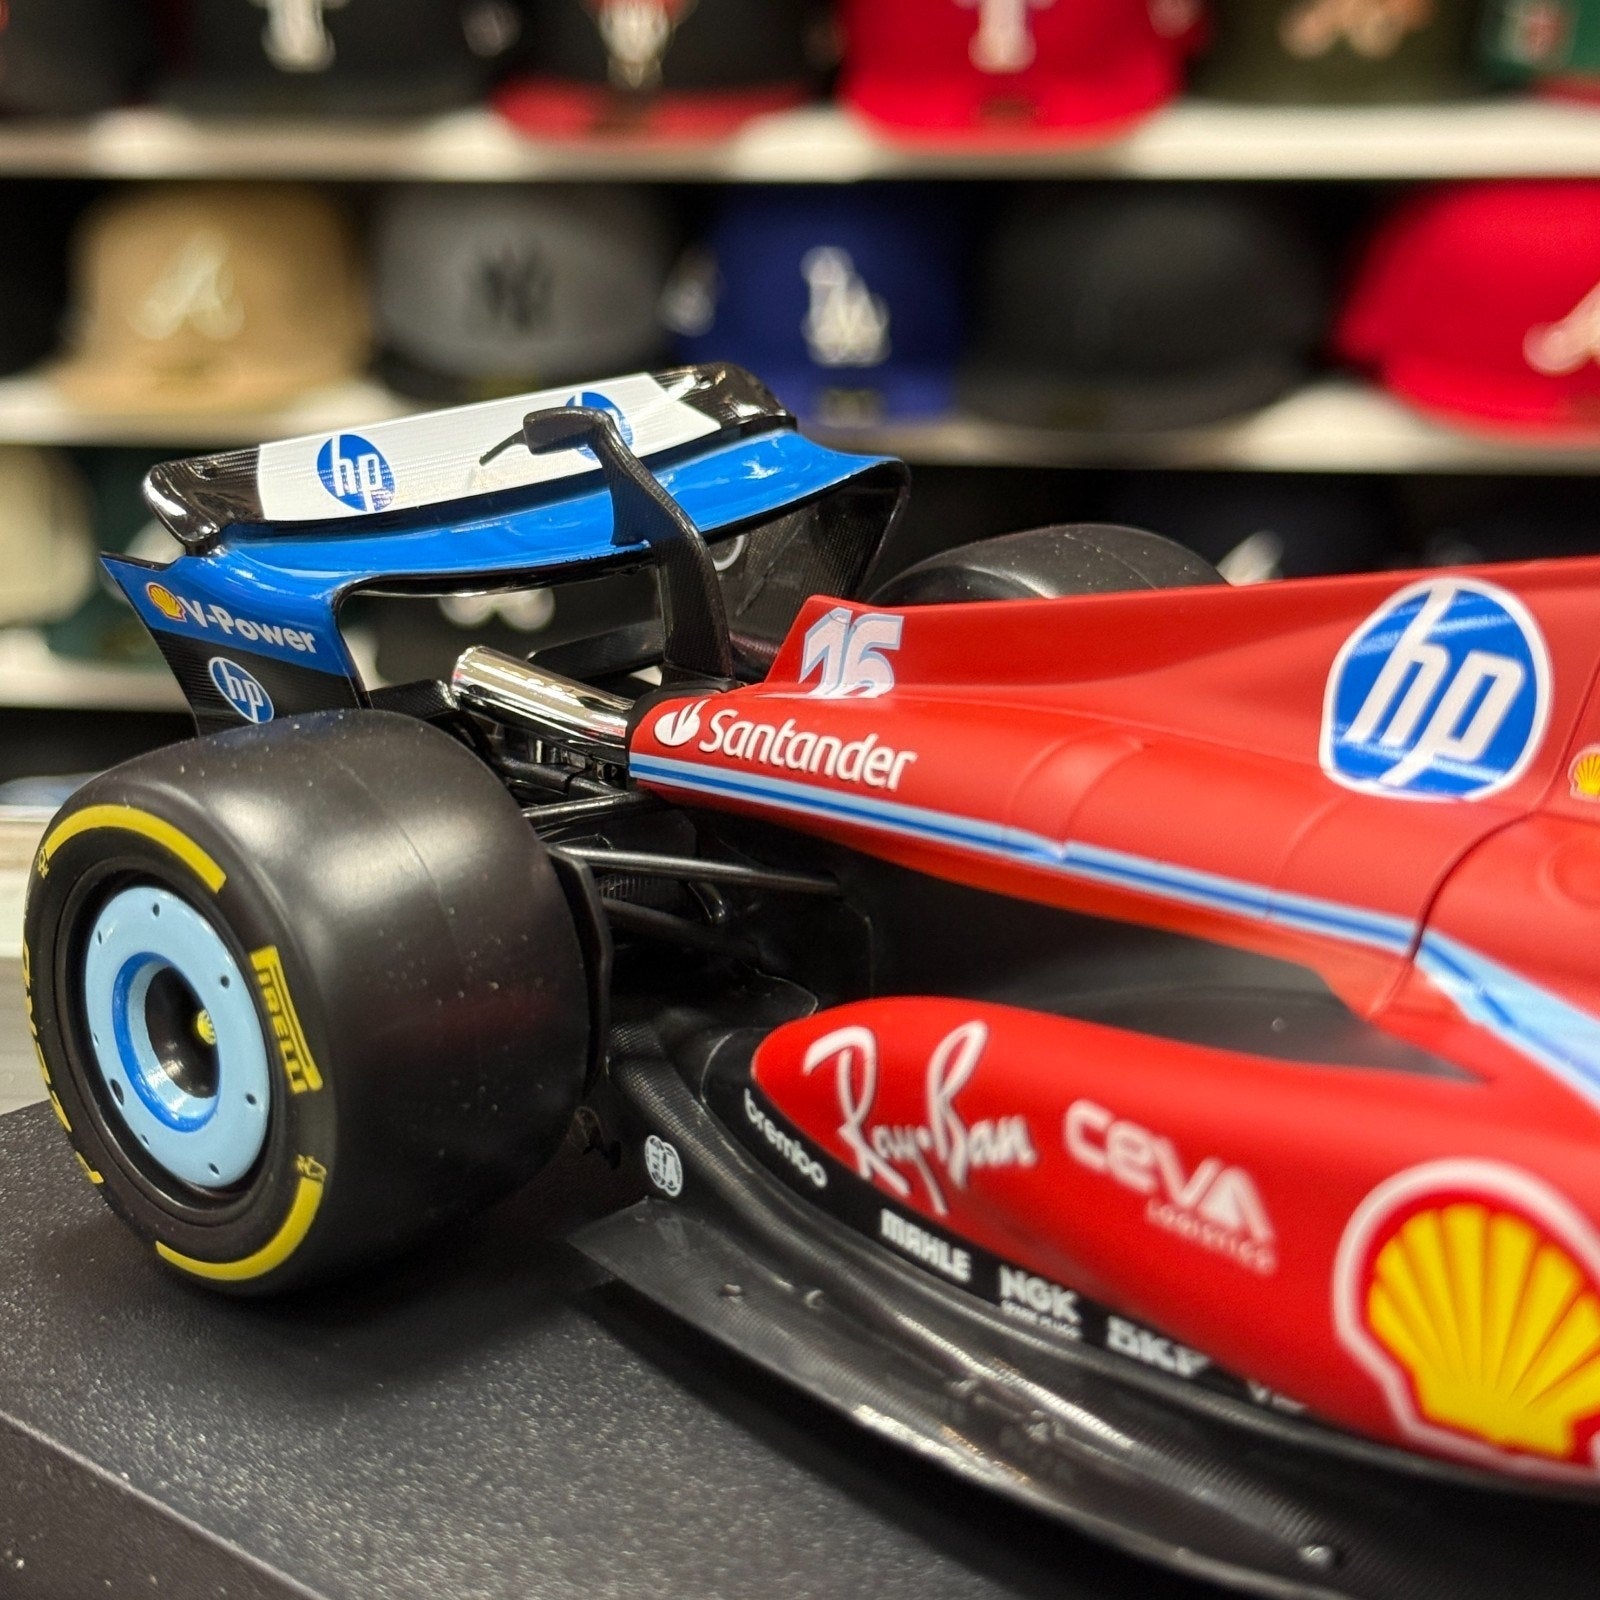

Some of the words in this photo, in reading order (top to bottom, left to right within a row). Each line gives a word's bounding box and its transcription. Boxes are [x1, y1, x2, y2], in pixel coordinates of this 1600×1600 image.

[329, 433, 384, 512] hp
[177, 595, 317, 654] V-Power
[799, 606, 904, 699] 16
[217, 658, 264, 723] hp
[1340, 578, 1526, 788] hp
[699, 708, 917, 791] Santander
[744, 1087, 827, 1188] brembo
[880, 1207, 972, 1283] MAHLE
[999, 1263, 1081, 1325] NGK
